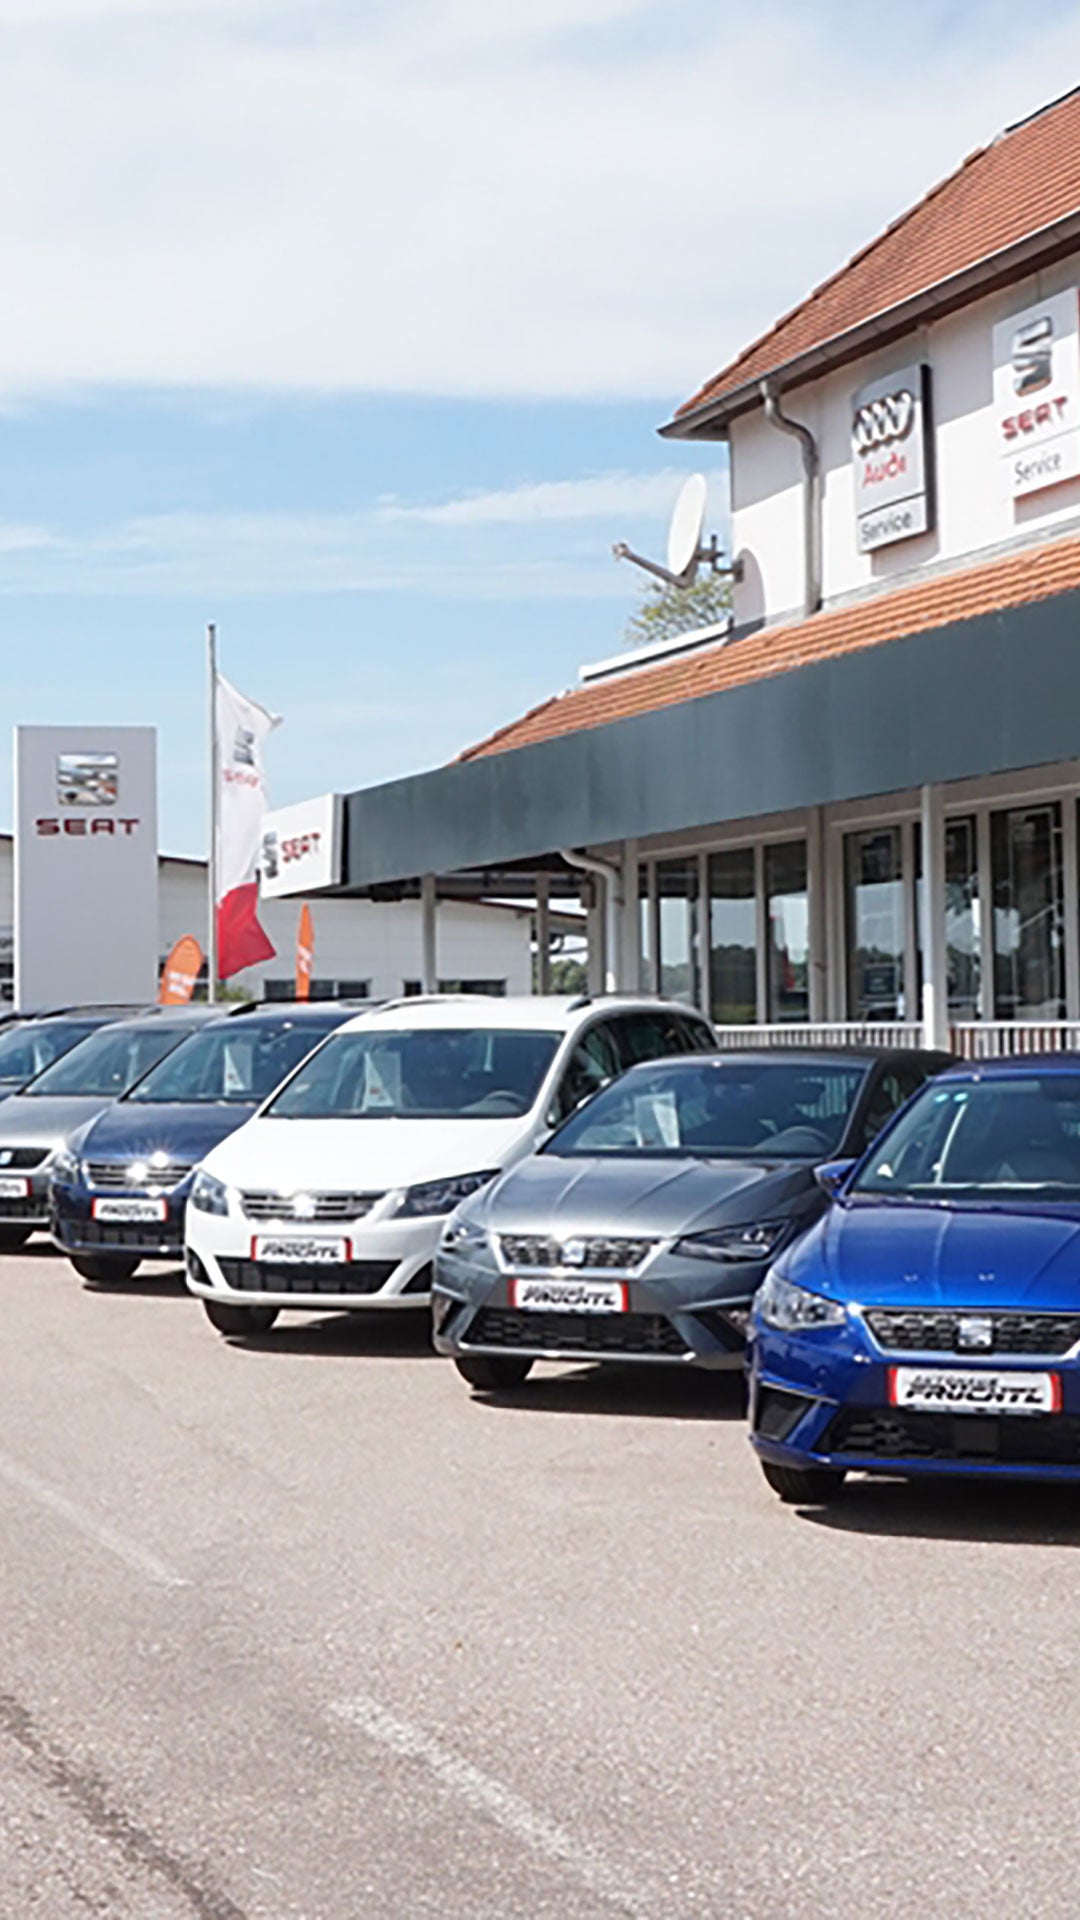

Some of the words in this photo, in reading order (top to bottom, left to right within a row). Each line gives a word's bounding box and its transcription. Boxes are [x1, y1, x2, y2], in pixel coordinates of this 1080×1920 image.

[1001, 395, 1068, 441] SEAT
[1015, 450, 1061, 485] Service
[861, 511, 912, 544] Service
[36, 818, 139, 836] SEAT
[281, 832, 320, 863] SEAT
